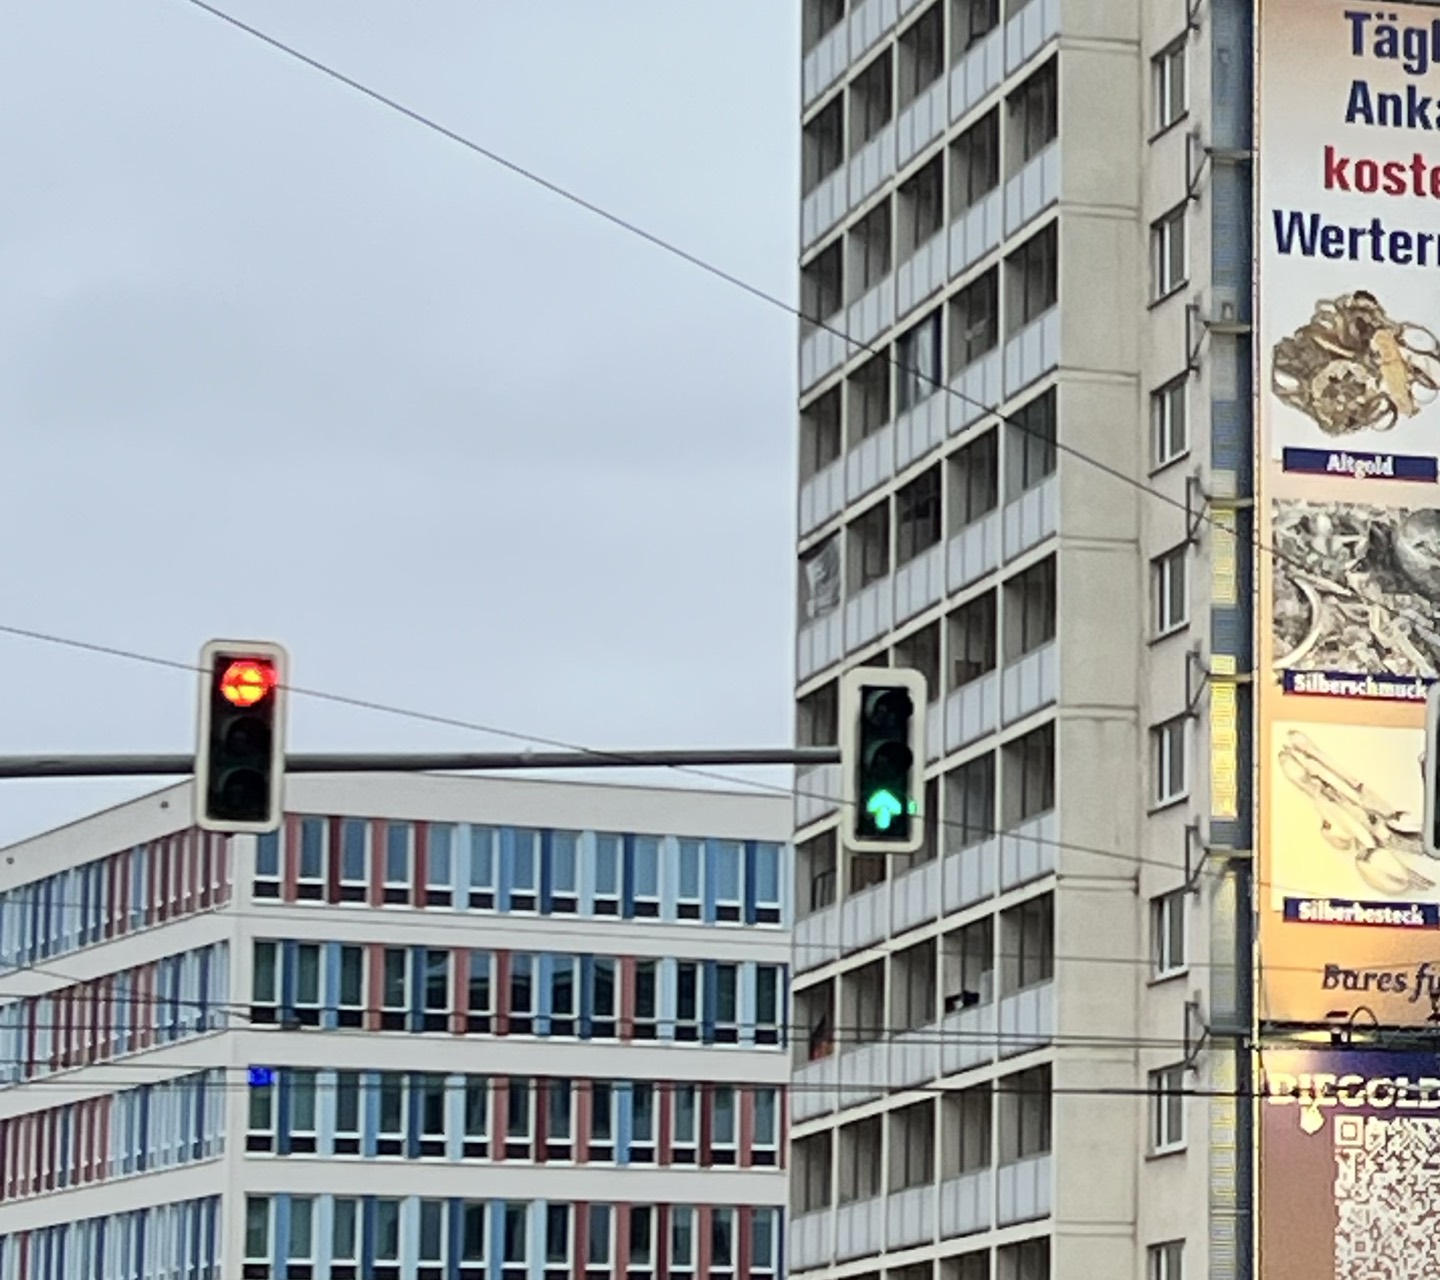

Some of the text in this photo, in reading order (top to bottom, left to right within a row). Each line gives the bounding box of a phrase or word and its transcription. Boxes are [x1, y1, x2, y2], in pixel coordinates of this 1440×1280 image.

[1326, 452, 1395, 480] Altgold
[1293, 672, 1427, 700] Silberschmuck
[1298, 900, 1425, 926] Silberbesteck
[1322, 963, 1408, 994] Bares
